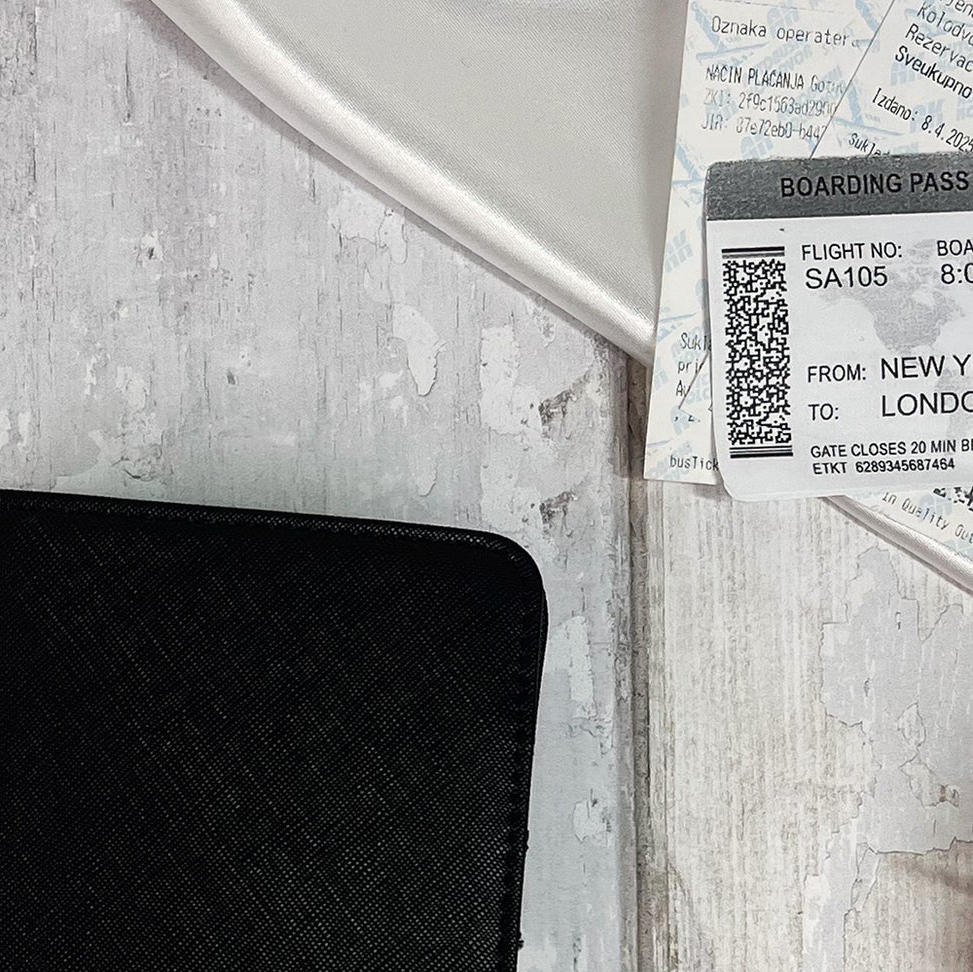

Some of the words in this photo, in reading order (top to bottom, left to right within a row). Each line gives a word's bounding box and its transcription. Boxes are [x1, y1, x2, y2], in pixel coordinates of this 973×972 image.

[711, 15, 767, 38] Oznaka
[895, 45, 973, 99] Sveukupno
[872, 88, 919, 121] Izdano:
[780, 173, 902, 198] BOARDING
[910, 170, 970, 193] PASS
[801, 243, 865, 261] FLIGHT
[871, 241, 903, 259] NO:
[805, 265, 888, 289] SA105
[807, 363, 867, 383] FROM:
[880, 354, 945, 380] NEW
[807, 402, 839, 421] TO:
[810, 444, 848, 459] GATE
[850, 441, 907, 457] CLOSES
[910, 440, 927, 455] 20
[930, 439, 956, 454] MIN
[812, 461, 848, 475] ETKT
[855, 457, 955, 474] 6289345687464
[901, 497, 949, 530] Quality
